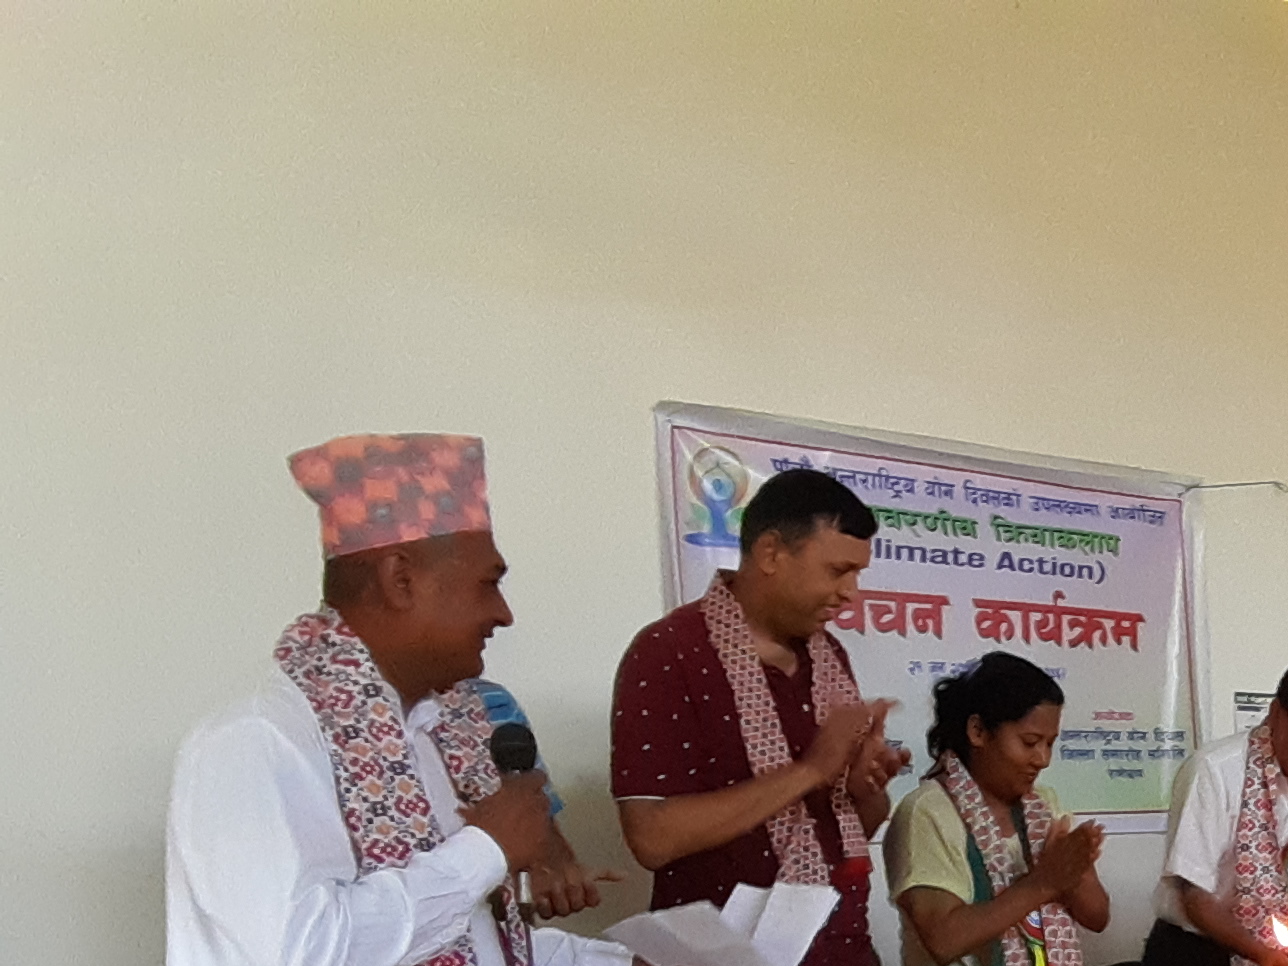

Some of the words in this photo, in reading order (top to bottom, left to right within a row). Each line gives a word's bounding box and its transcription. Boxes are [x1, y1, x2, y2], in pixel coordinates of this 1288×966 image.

[874, 537, 986, 569] limate
[995, 551, 1107, 585] Action)
[833, 588, 952, 641] वचन
[971, 589, 1147, 653] कार्यक्रम
